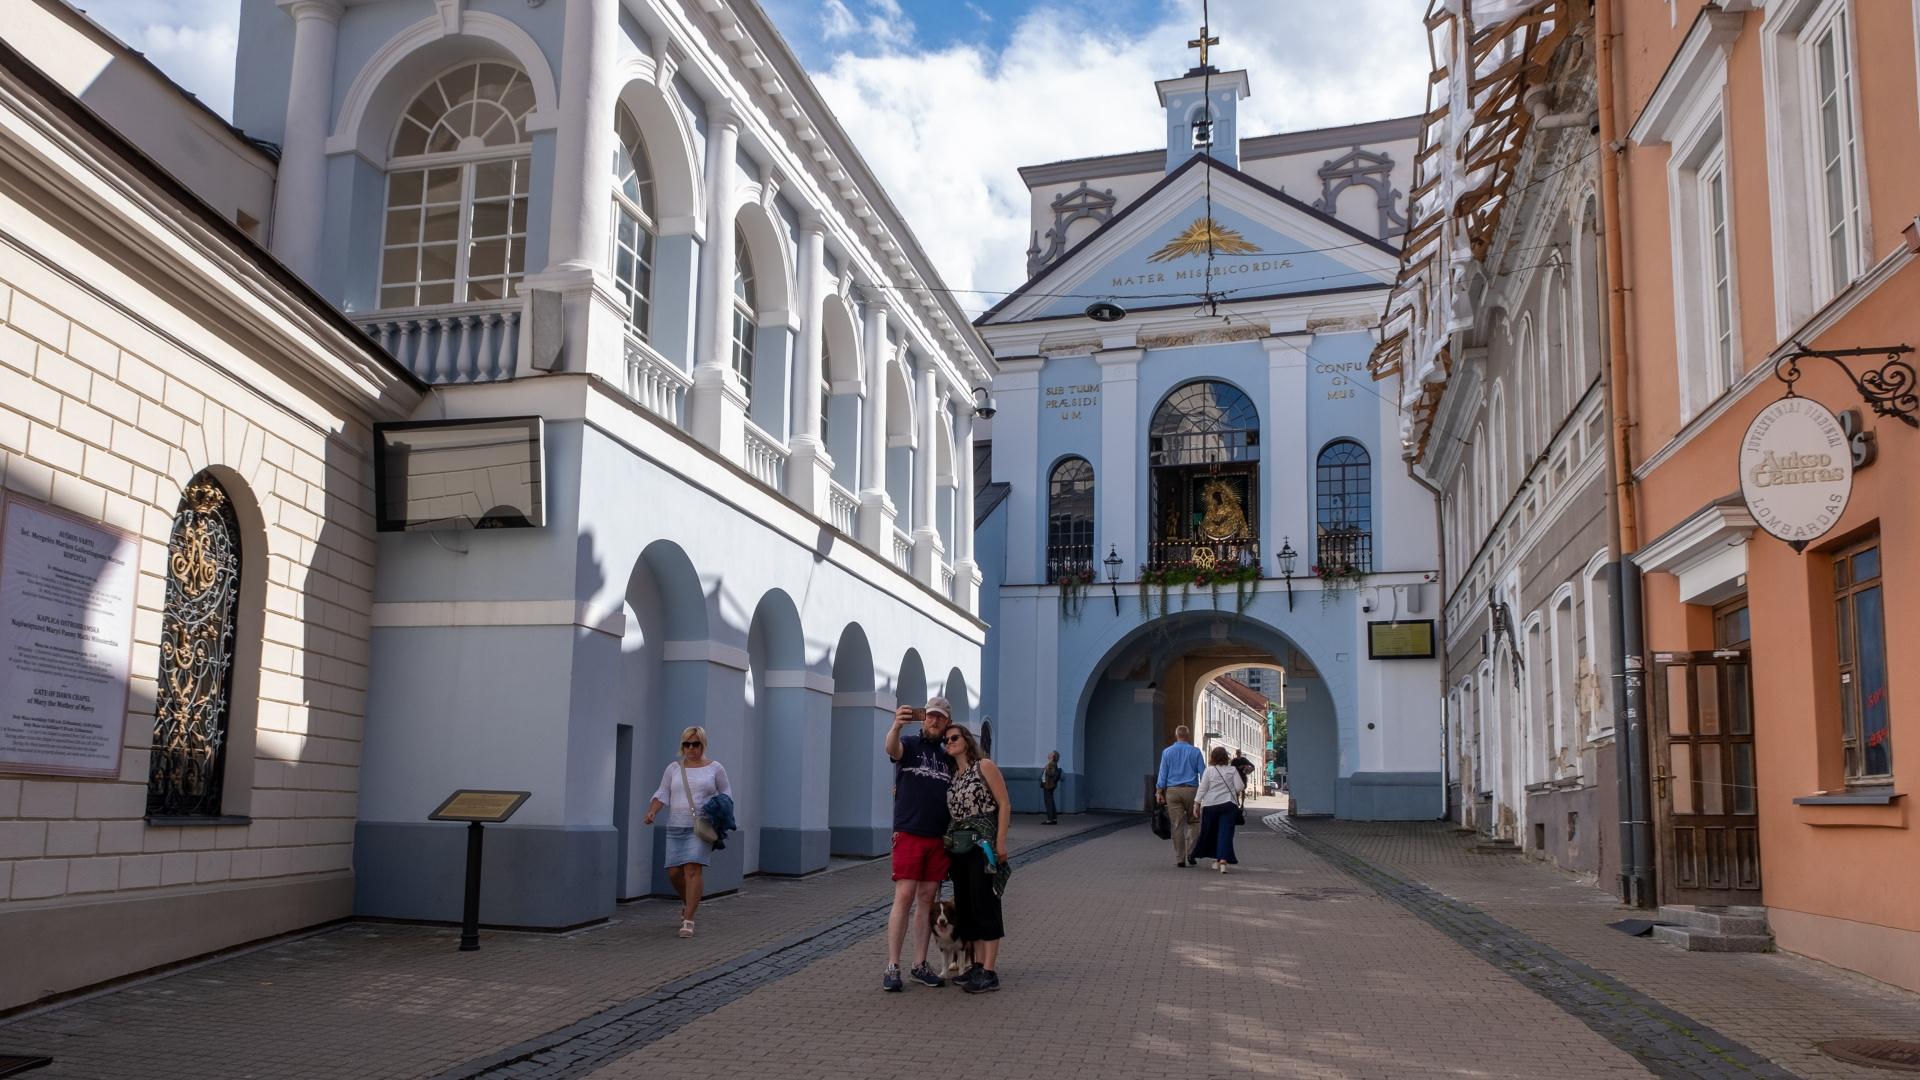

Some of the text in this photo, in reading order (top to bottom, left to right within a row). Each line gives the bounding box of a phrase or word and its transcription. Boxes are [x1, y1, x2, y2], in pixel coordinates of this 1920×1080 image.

[1112, 273, 1165, 287] MATER
[1315, 362, 1362, 374] CONFU
[1331, 376, 1347, 386] GI
[1046, 384, 1100, 396] SUB TUUM
[1327, 389, 1356, 400] MUS
[1046, 397, 1097, 408] PRÆSIDI
[1762, 449, 1832, 471] Aukso
[1750, 464, 1845, 488] Centras
[1752, 493, 1843, 537] LOMBARDAS
[33, 687, 48, 697] GATE
[33, 697, 47, 708] Mary
